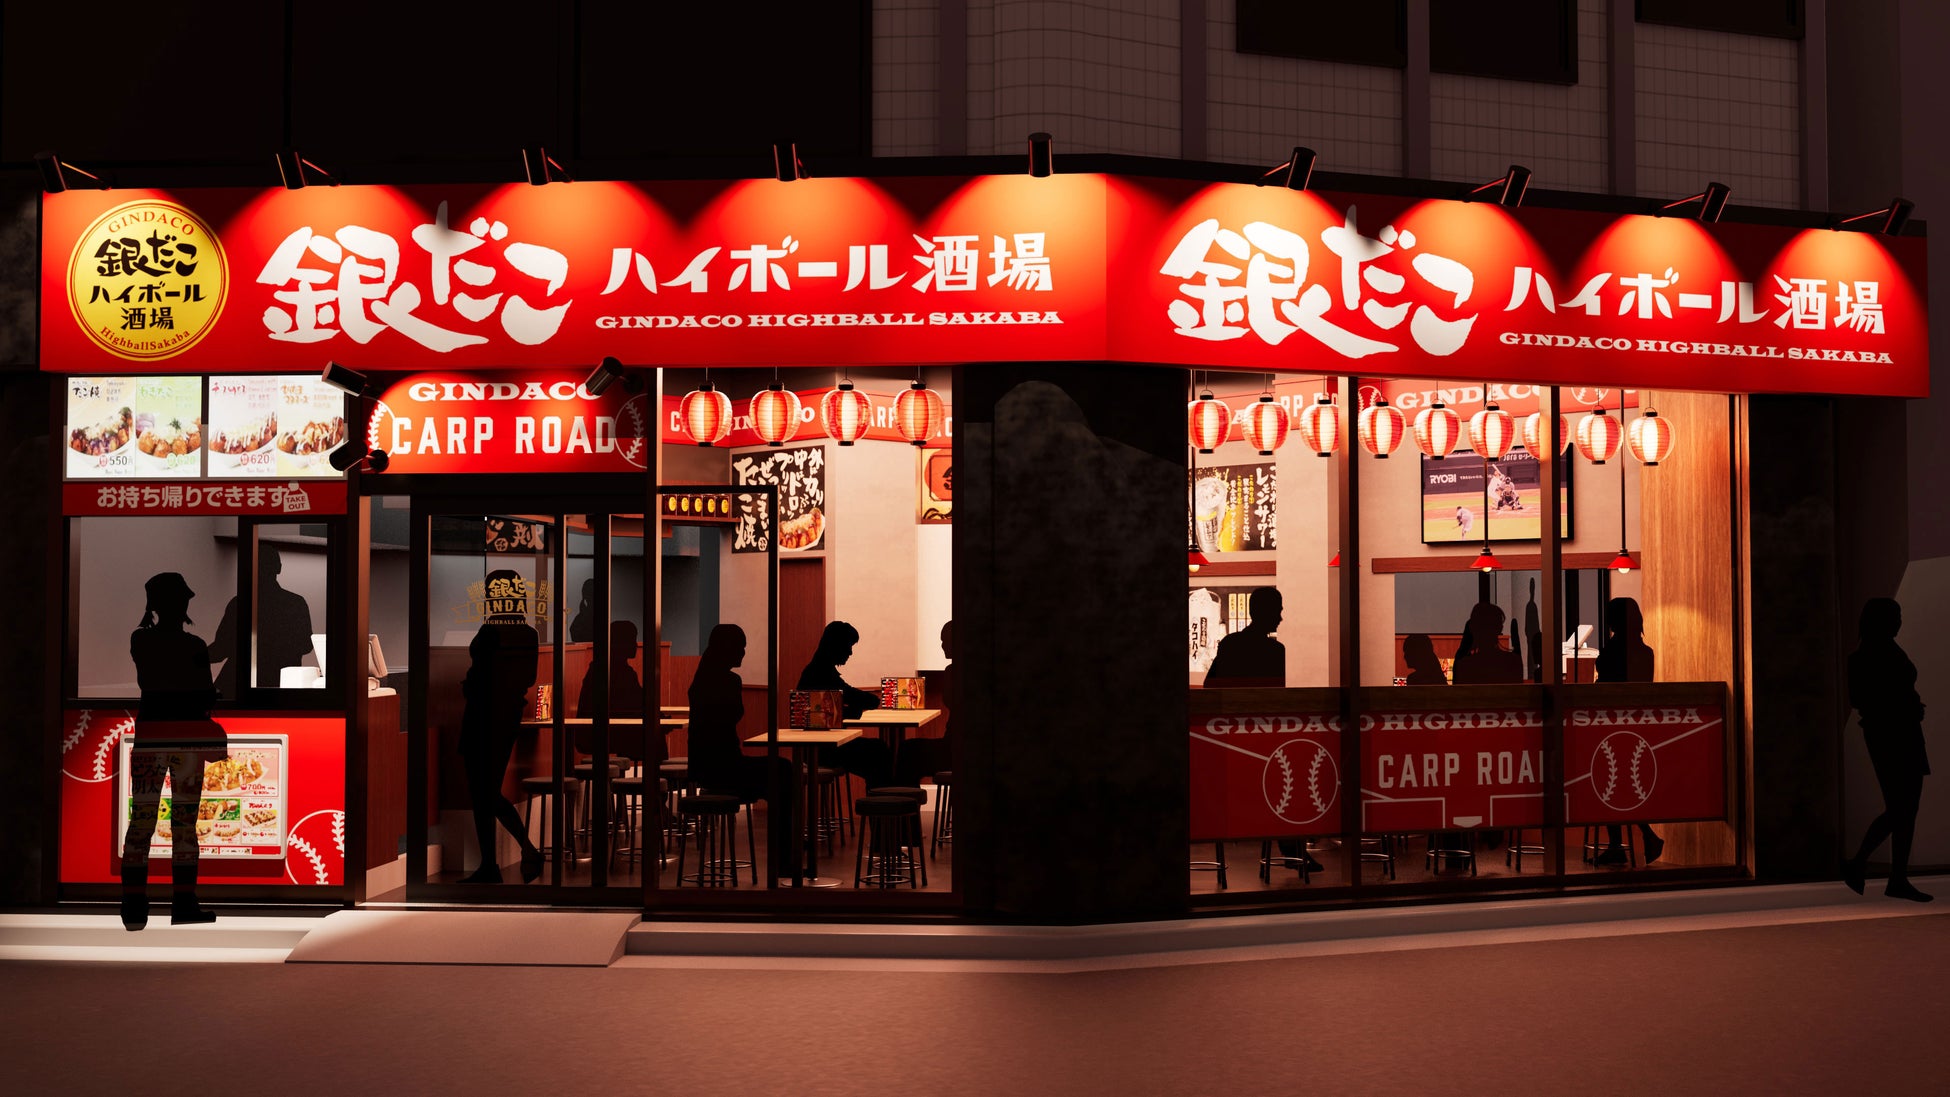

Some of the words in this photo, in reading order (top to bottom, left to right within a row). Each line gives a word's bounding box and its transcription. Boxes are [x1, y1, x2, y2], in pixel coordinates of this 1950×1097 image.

[108, 211, 194, 236] GINDACO
[94, 229, 198, 277] 銀だこ
[256, 201, 573, 353] 銀だこ
[600, 232, 1053, 294] ハイボール酒場
[1159, 205, 1478, 359] 銀だこ
[1504, 266, 1886, 335] ハイボール酒場
[89, 281, 207, 304] ハイボール
[120, 307, 174, 330] 酒場
[595, 314, 743, 329] GINDACO
[747, 312, 924, 327] HIGHBALL
[929, 311, 1064, 326] SAKABA
[1499, 332, 1633, 351] GINDACO
[1636, 338, 1785, 360] HIGHBALL
[1787, 346, 1894, 365] SAKABA
[392, 416, 494, 454] CARP
[515, 416, 615, 454] ROAD
[1429, 473, 1457, 485] RYOBI
[97, 486, 289, 509] お持ち帰りできます
[288, 503, 305, 511] OUT
[1254, 467, 1270, 548] レモンサワー
[488, 575, 536, 599] 銀だこ
[1380, 712, 1567, 731] HIGHBAL
[1573, 708, 1703, 727] SAKABA
[1378, 752, 1460, 789] CARP
[1477, 750, 1543, 785] ROA
